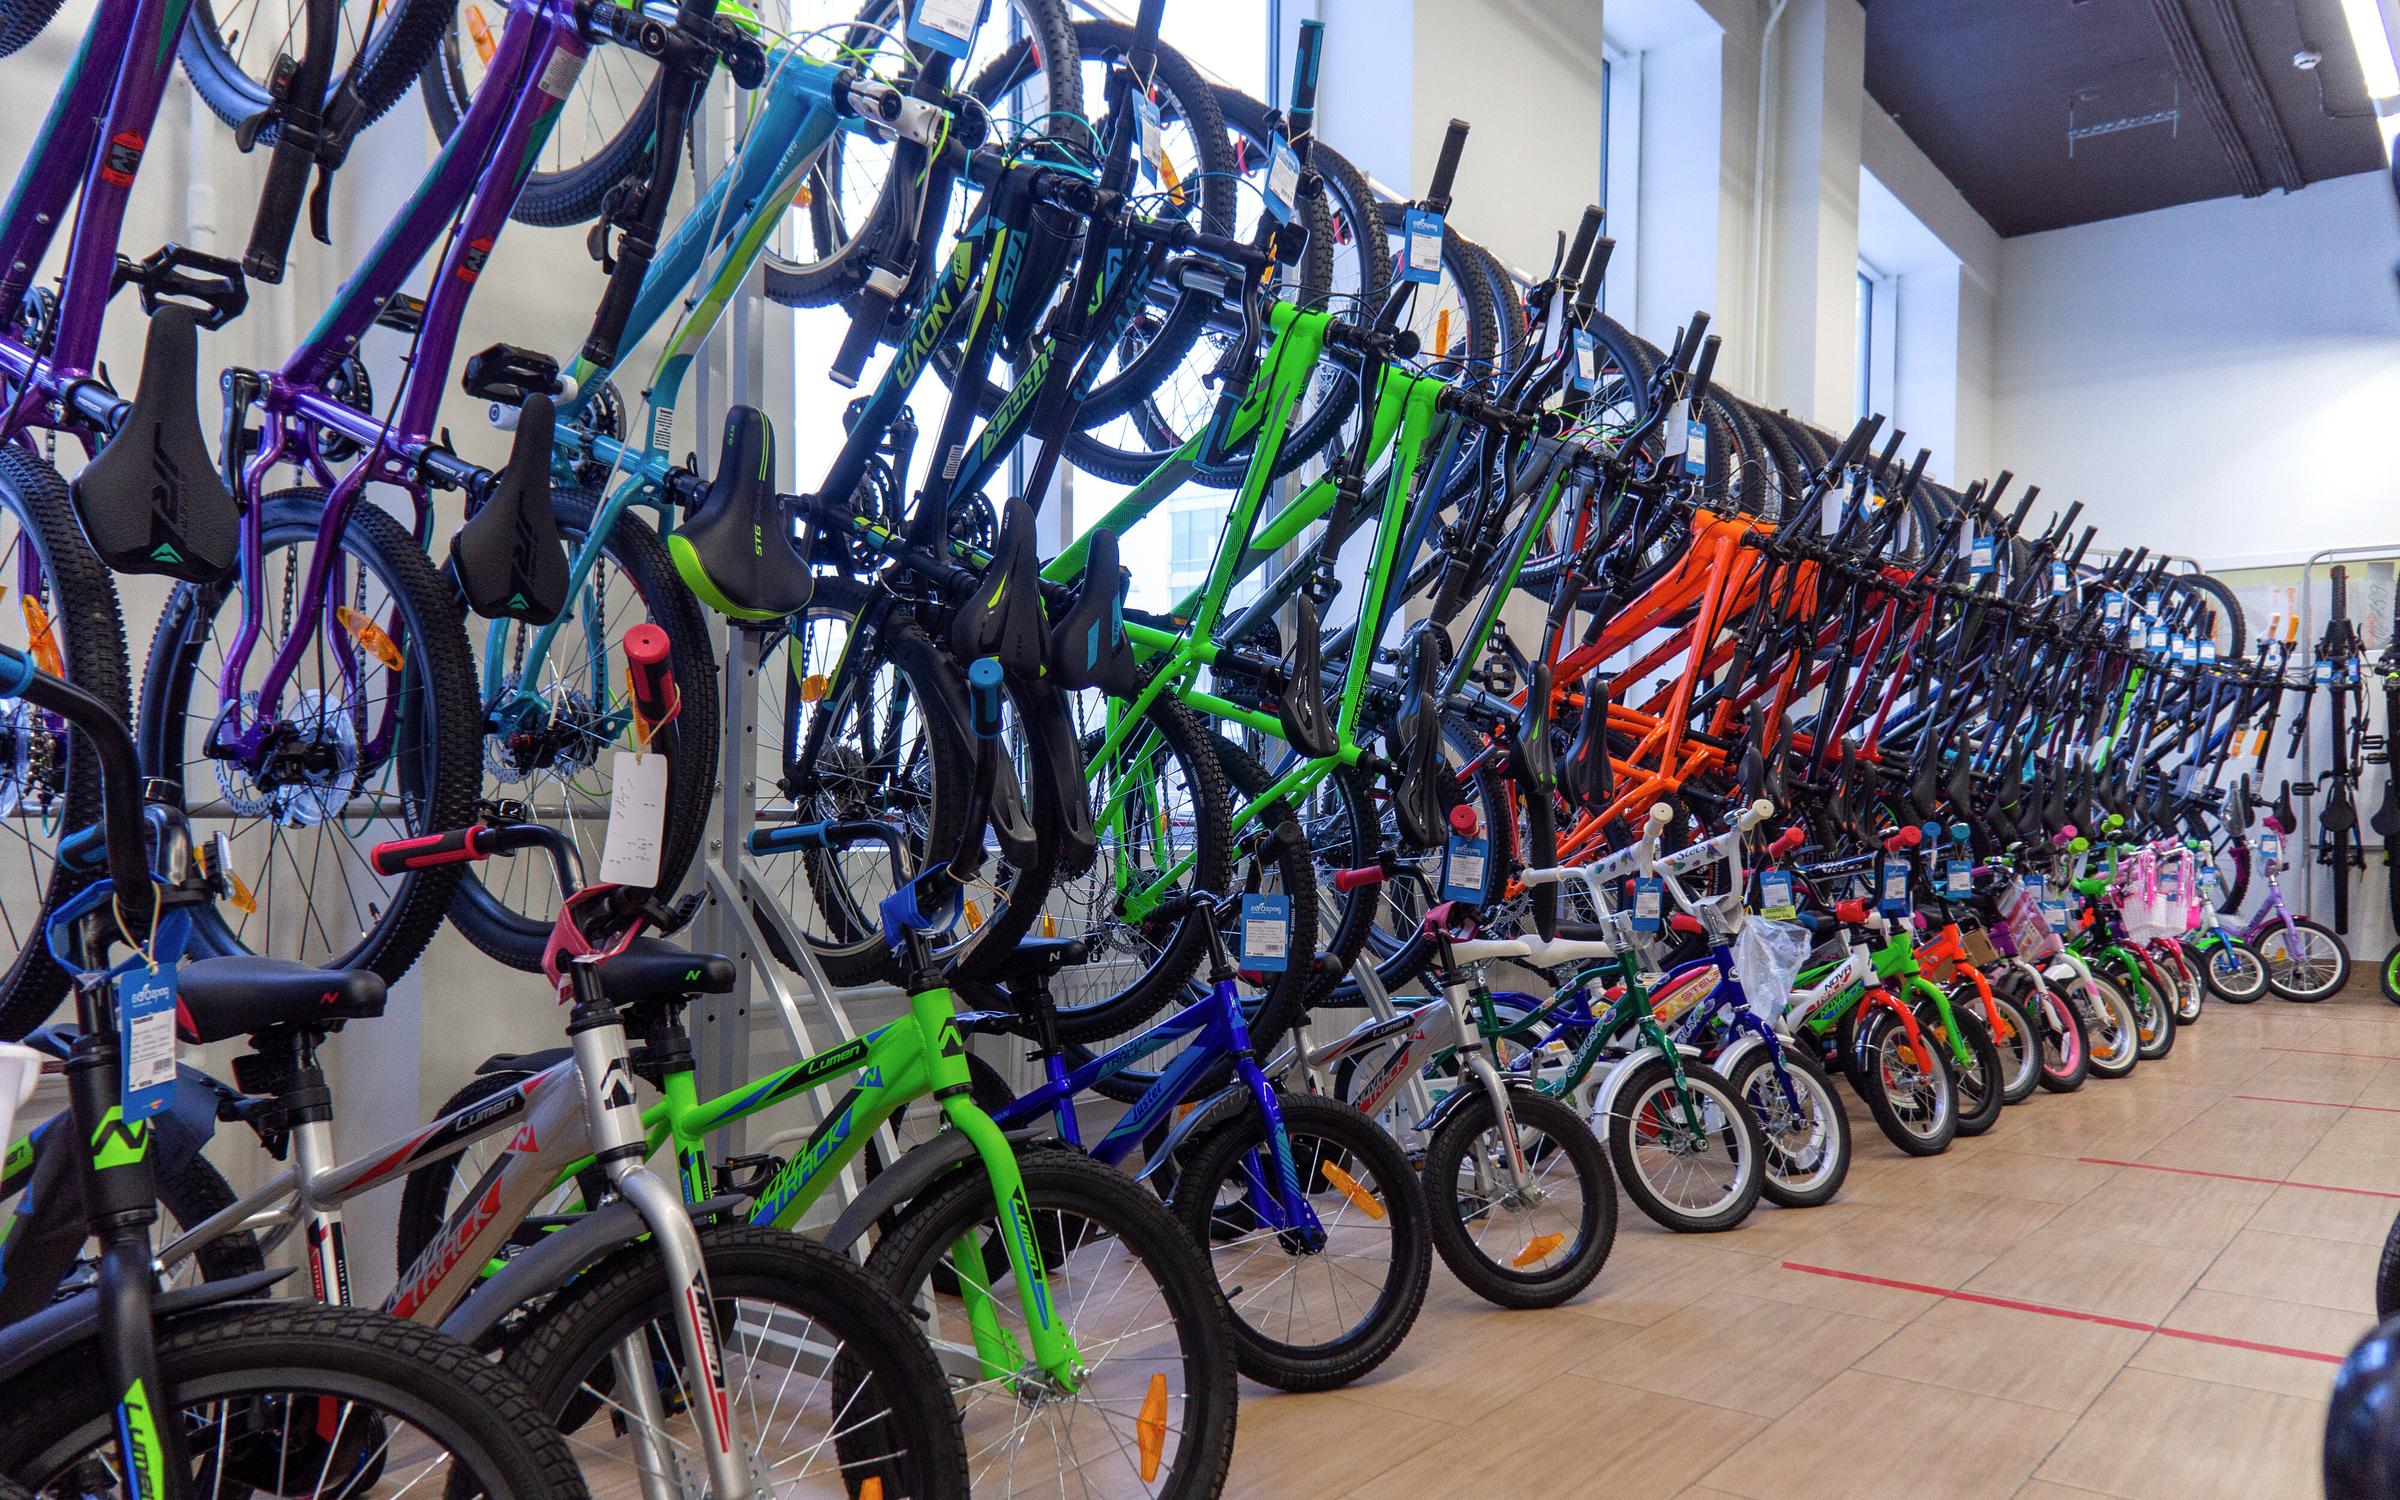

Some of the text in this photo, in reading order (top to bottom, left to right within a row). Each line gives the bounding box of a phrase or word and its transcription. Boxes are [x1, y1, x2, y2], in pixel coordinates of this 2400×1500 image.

[897, 288, 952, 388] NOVA
[985, 352, 1049, 442] TRACK
[754, 524, 763, 557] STG
[1680, 969, 1721, 1001] STELS
[807, 1045, 861, 1075] Lumen
[1373, 1019, 1409, 1037] Lumen
[455, 1096, 515, 1132] Lumen
[773, 1121, 846, 1213] TRACK
[409, 1195, 492, 1306] TRACK
[1013, 1199, 1042, 1271] Lumen
[695, 1287, 723, 1379] Lumen
[127, 1402, 155, 1500] Lume
